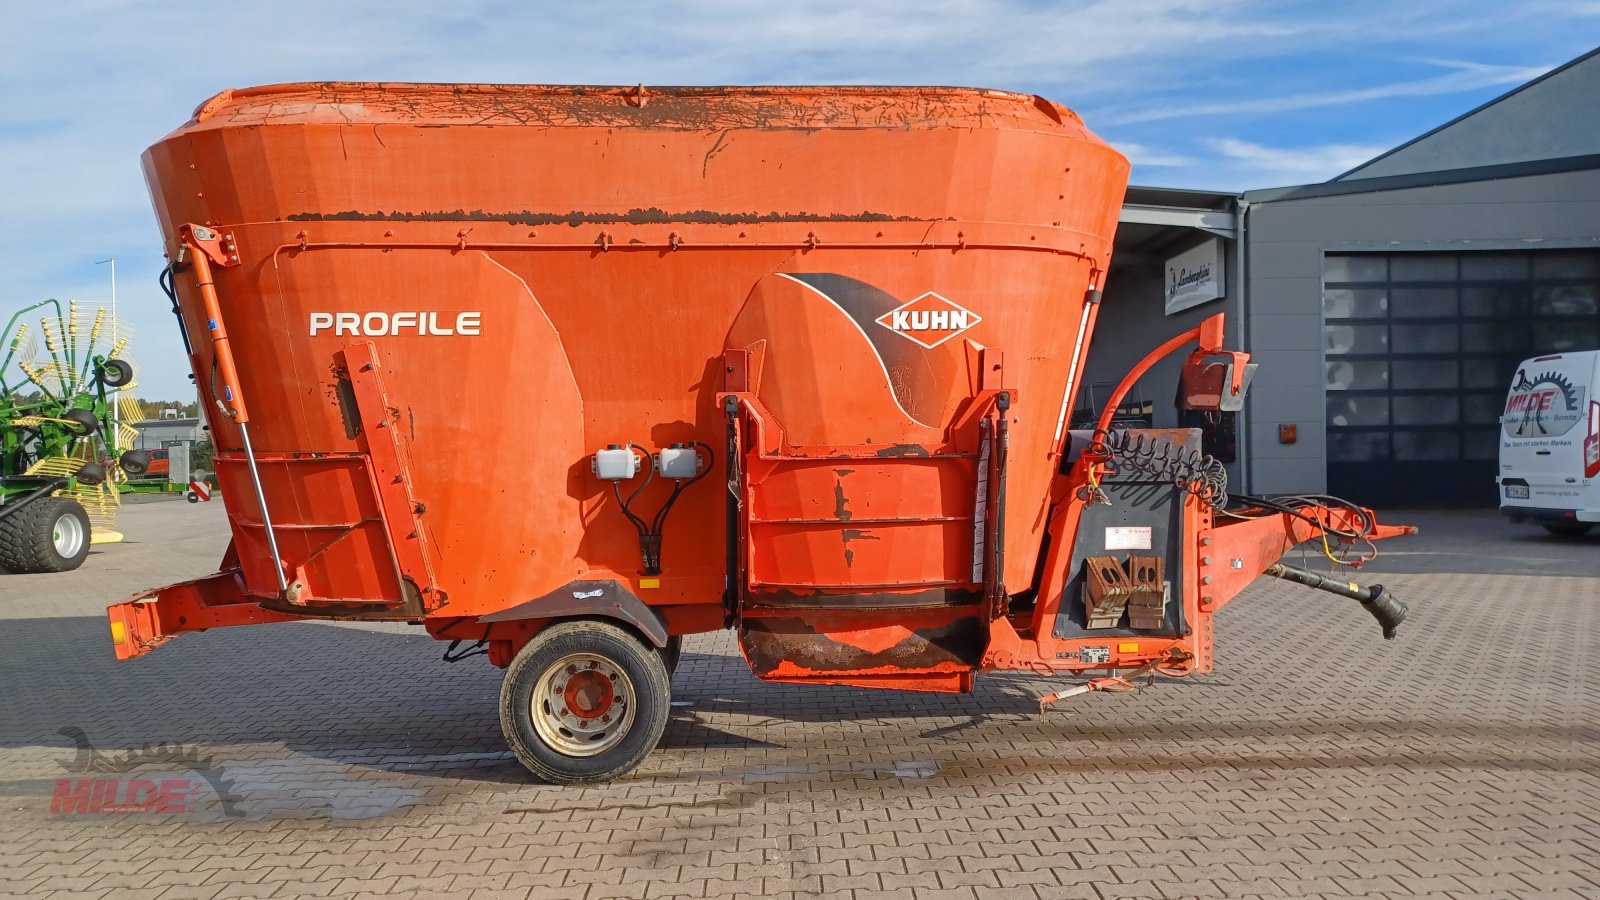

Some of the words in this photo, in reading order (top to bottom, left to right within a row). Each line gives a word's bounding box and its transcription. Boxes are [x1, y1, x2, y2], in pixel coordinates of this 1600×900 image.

[309, 312, 481, 336] PROFILE
[892, 310, 968, 330] KUHN
[1506, 392, 1555, 414] MILDE
